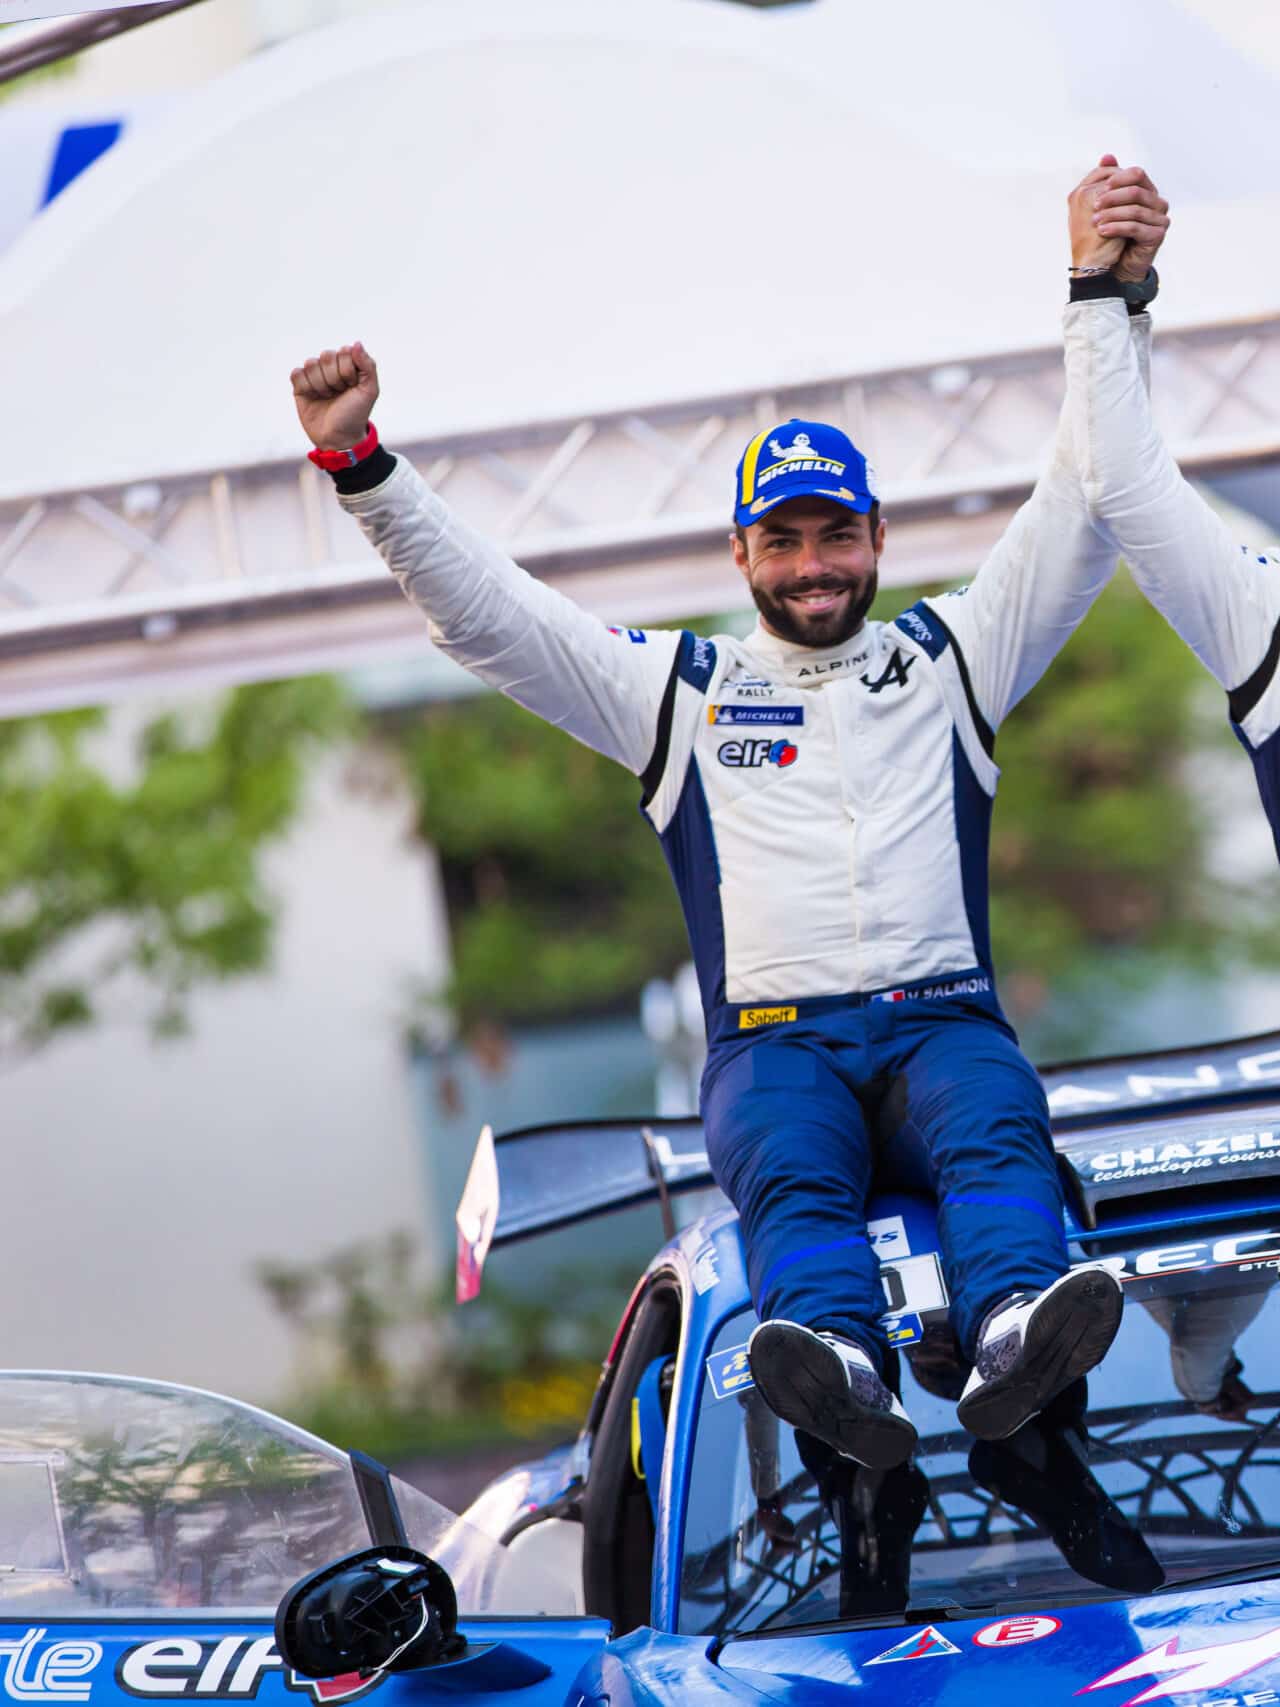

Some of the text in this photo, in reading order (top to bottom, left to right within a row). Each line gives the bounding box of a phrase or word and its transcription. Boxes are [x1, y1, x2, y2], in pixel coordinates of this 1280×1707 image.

[757, 460, 845, 488] MICHELIN
[798, 652, 869, 677] ALPINE
[737, 688, 775, 697] RALLY
[735, 711, 797, 721] MICHELIN
[718, 740, 770, 768] elf
[746, 1009, 791, 1027] Sabelt
[1093, 1157, 1214, 1183] technologie
